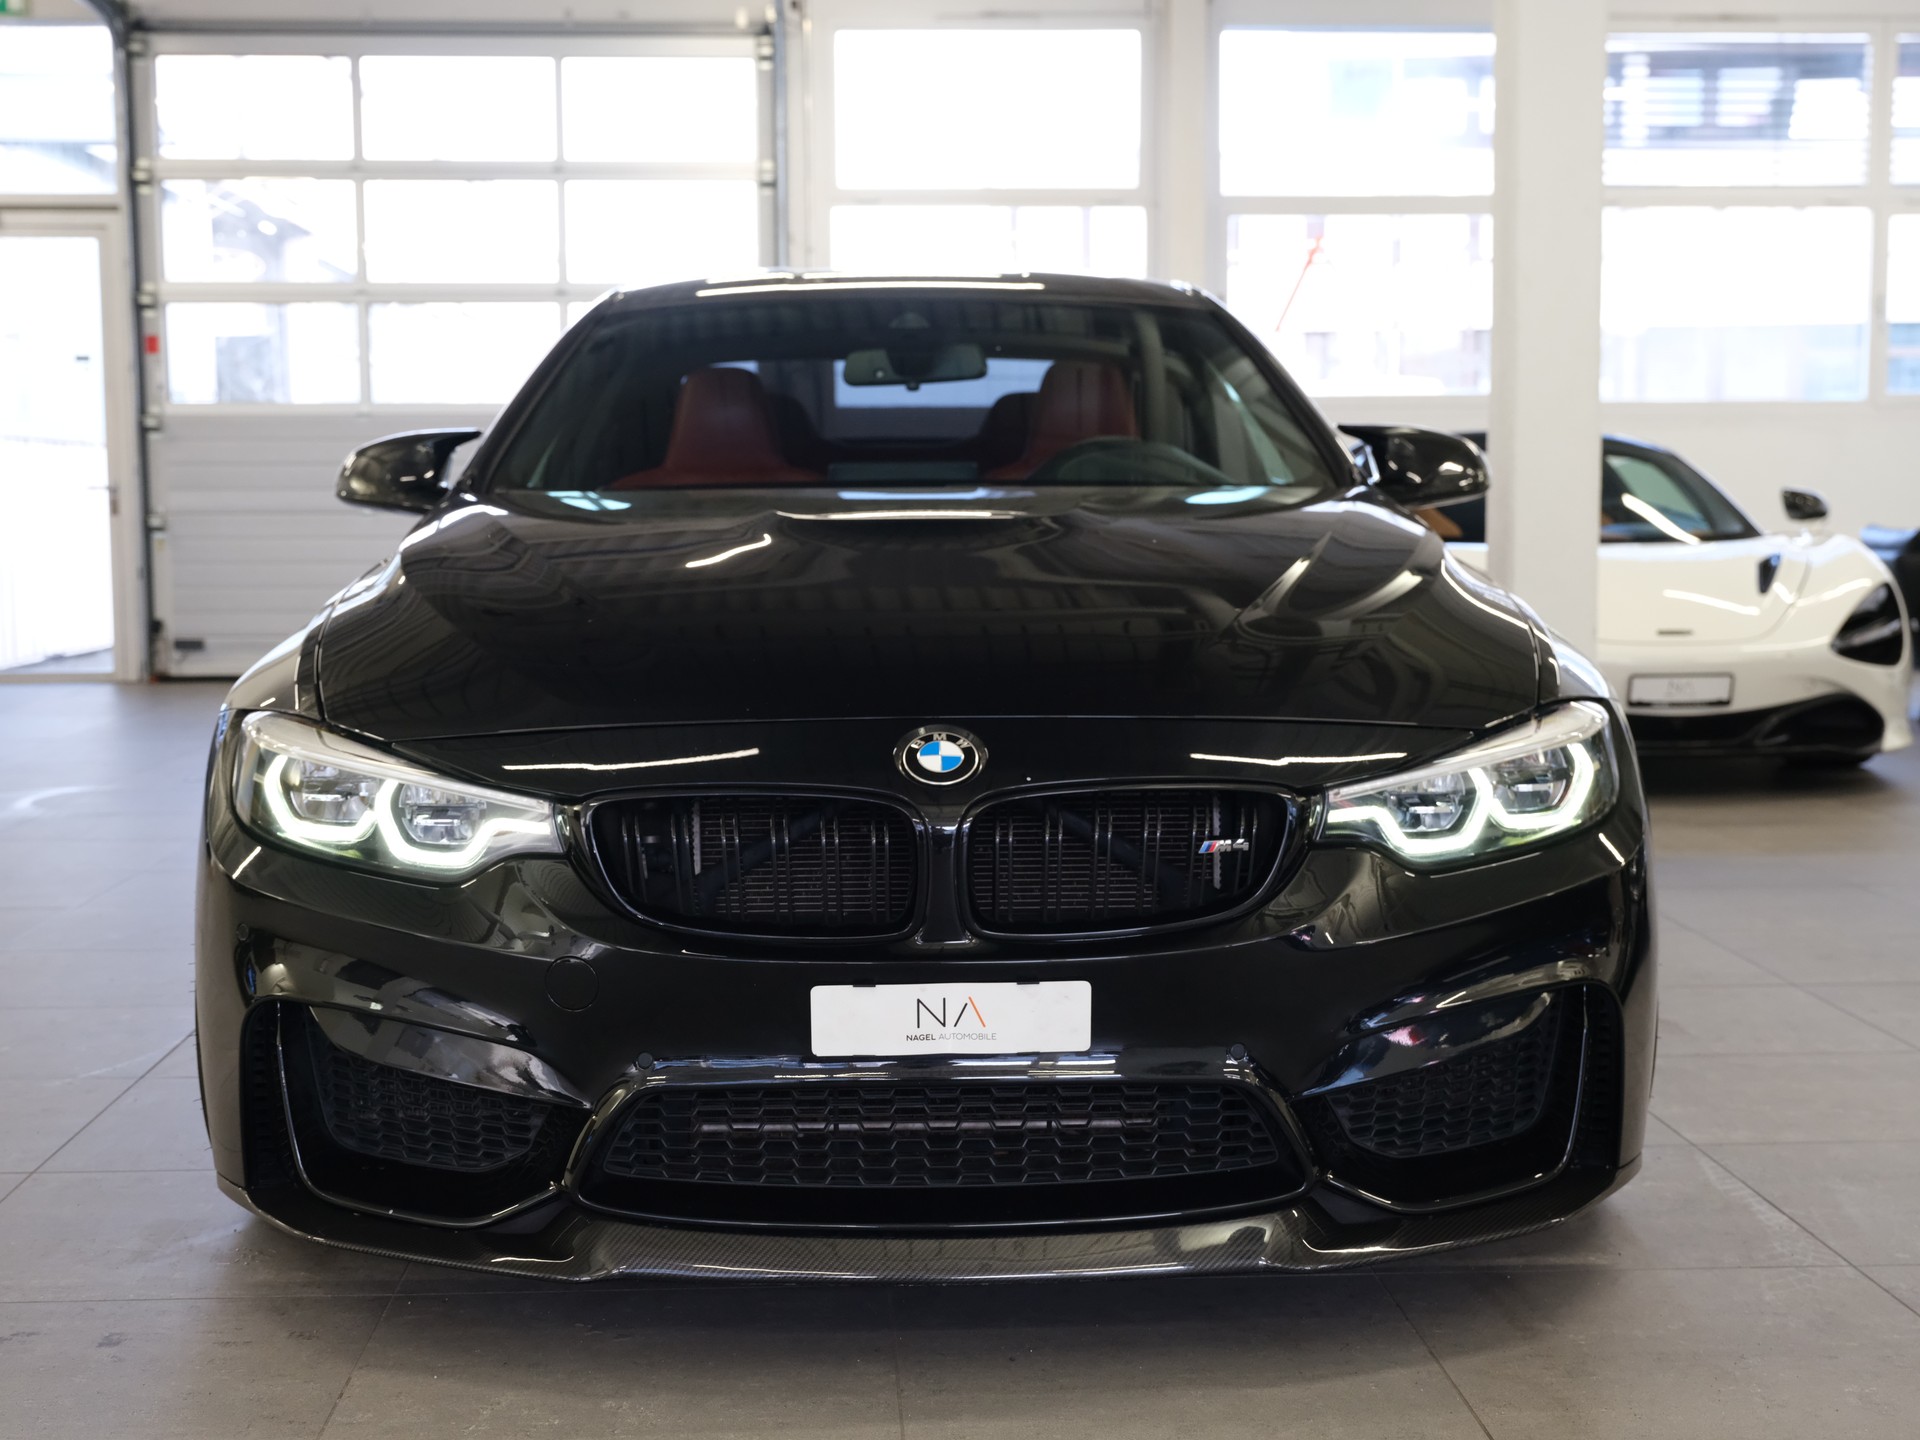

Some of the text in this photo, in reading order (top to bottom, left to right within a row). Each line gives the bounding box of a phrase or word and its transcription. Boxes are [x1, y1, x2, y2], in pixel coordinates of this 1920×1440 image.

[910, 733, 972, 749] BMW
[1212, 838, 1249, 852] M4
[938, 1032, 997, 1041] AUTOMOBILE
